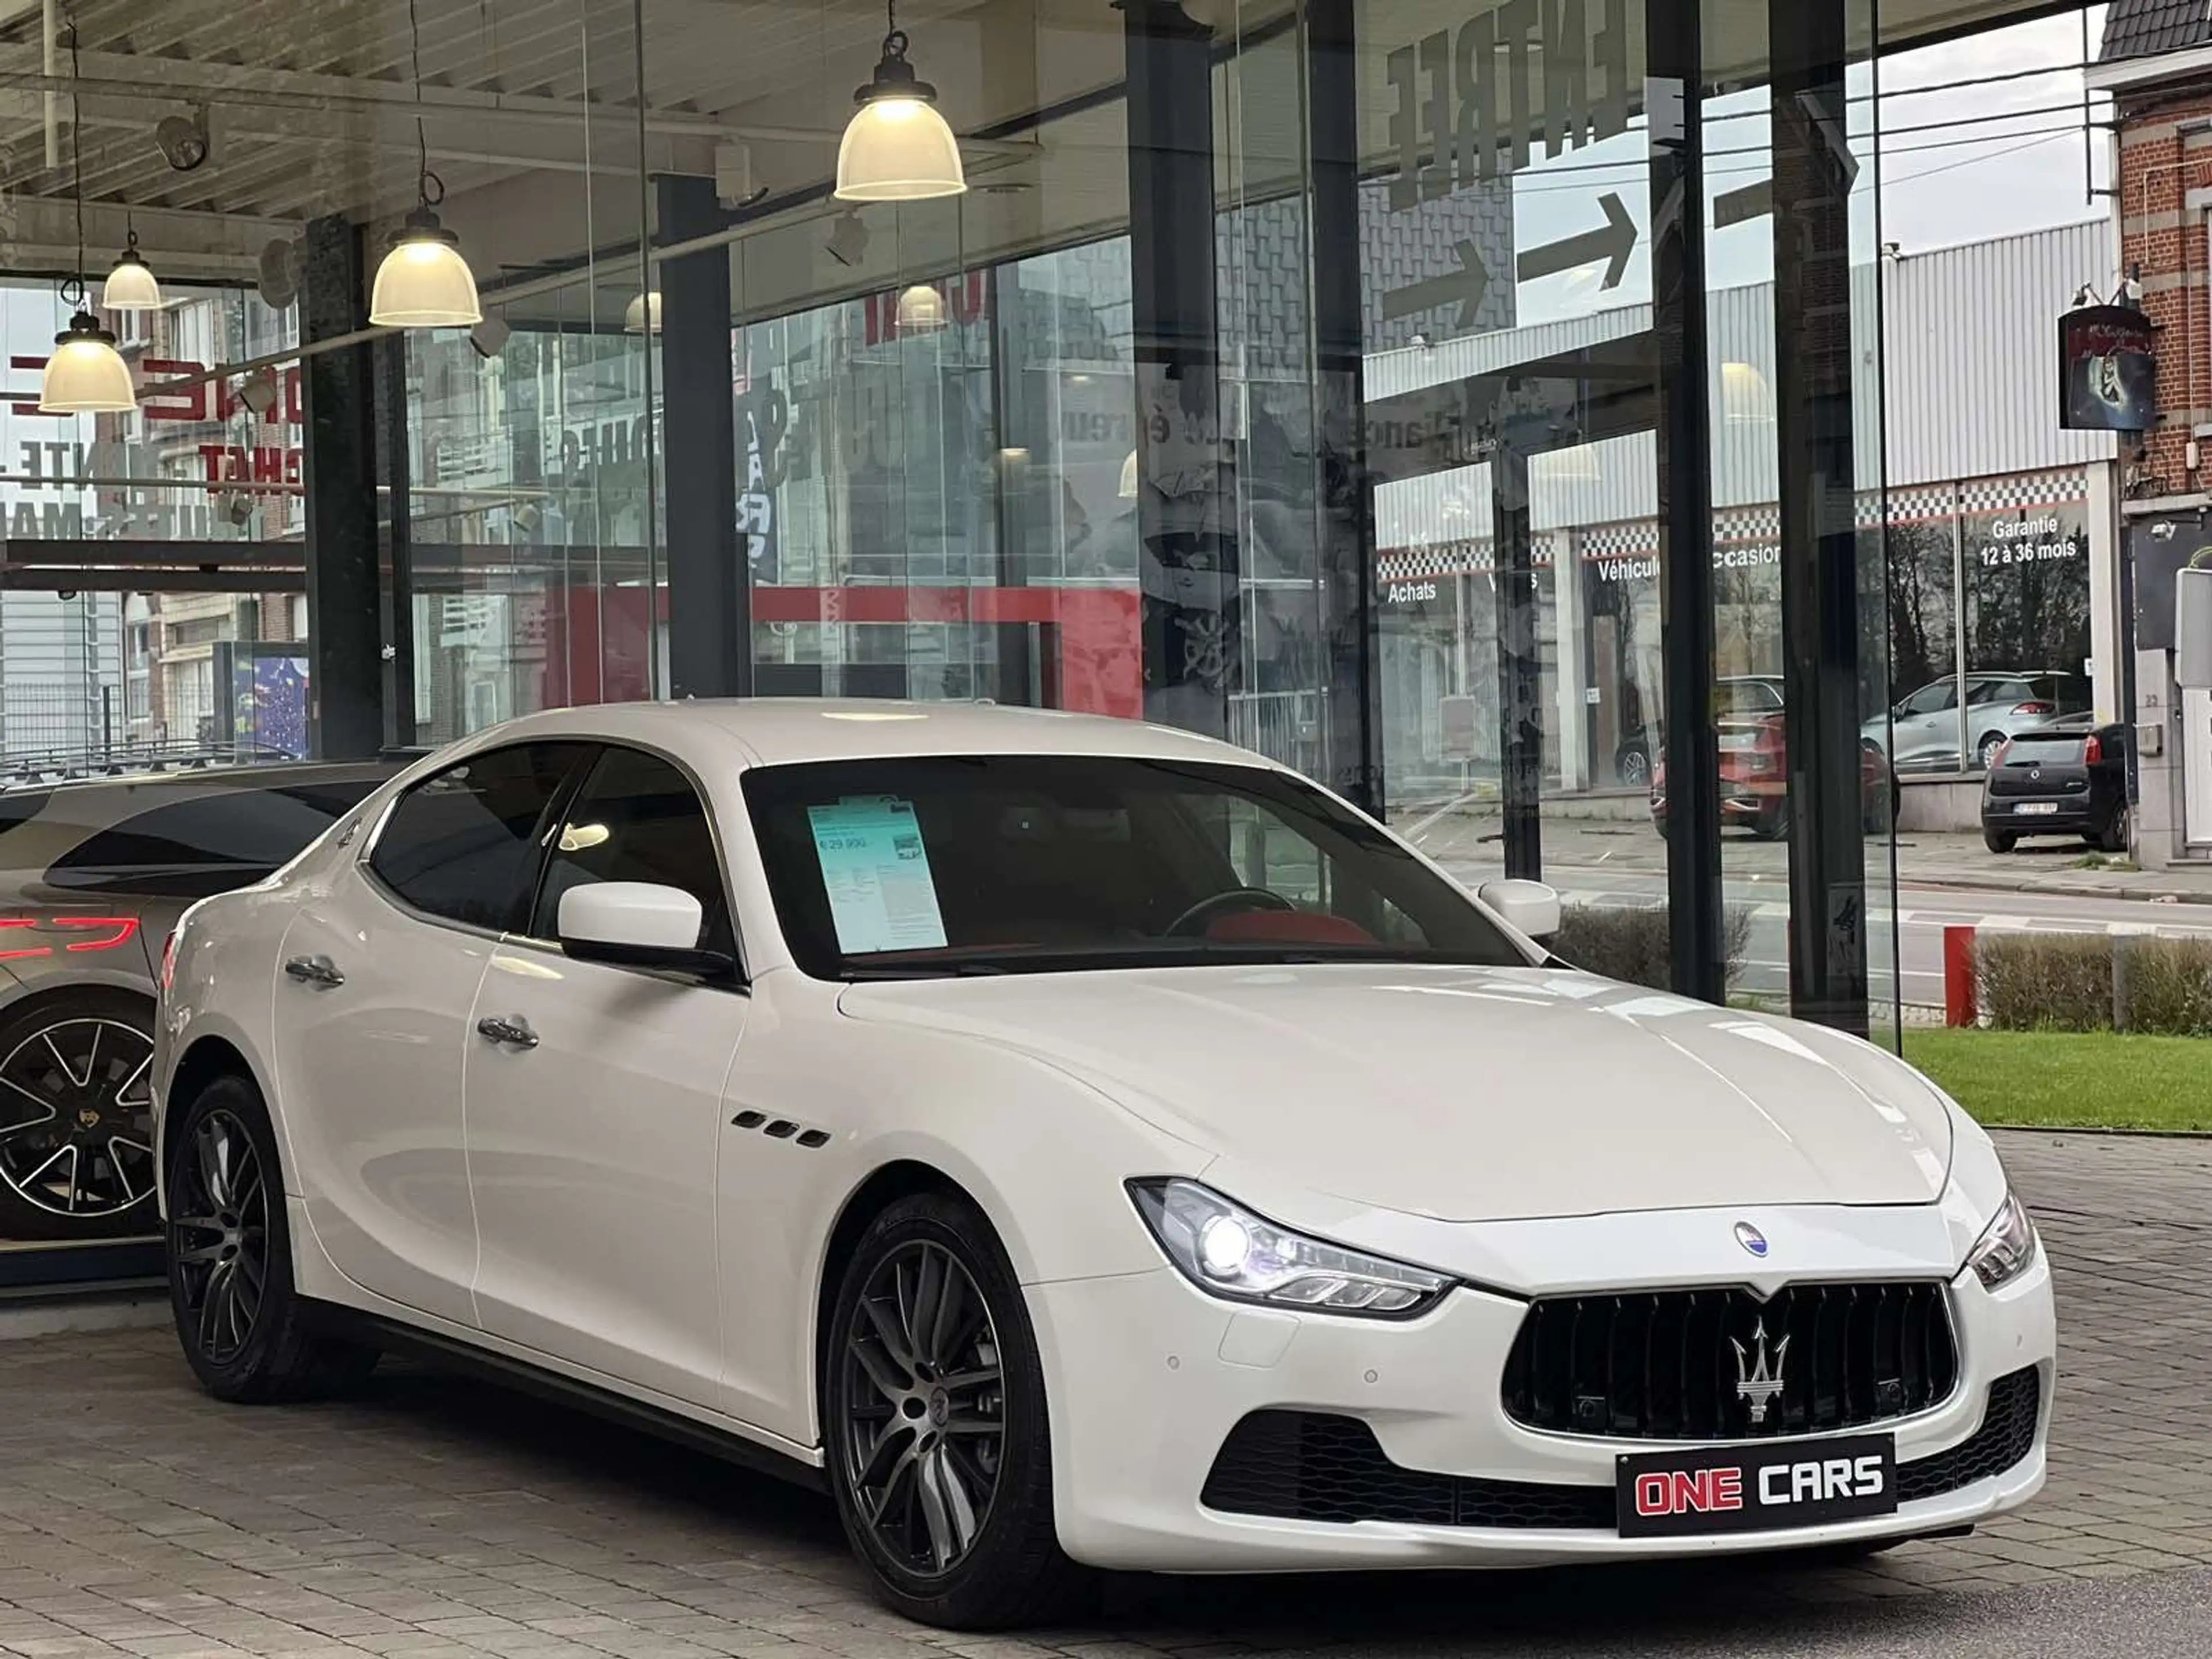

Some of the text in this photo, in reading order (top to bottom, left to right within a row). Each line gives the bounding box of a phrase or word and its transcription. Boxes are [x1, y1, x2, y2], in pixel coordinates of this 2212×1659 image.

[1993, 516, 2058, 539] Garantie
[1981, 538, 2077, 566] 12 à 36 mois
[1598, 555, 1660, 582] Véhicul
[1388, 581, 1437, 603] Achats
[1635, 1455, 1884, 1516] ONE CARS
